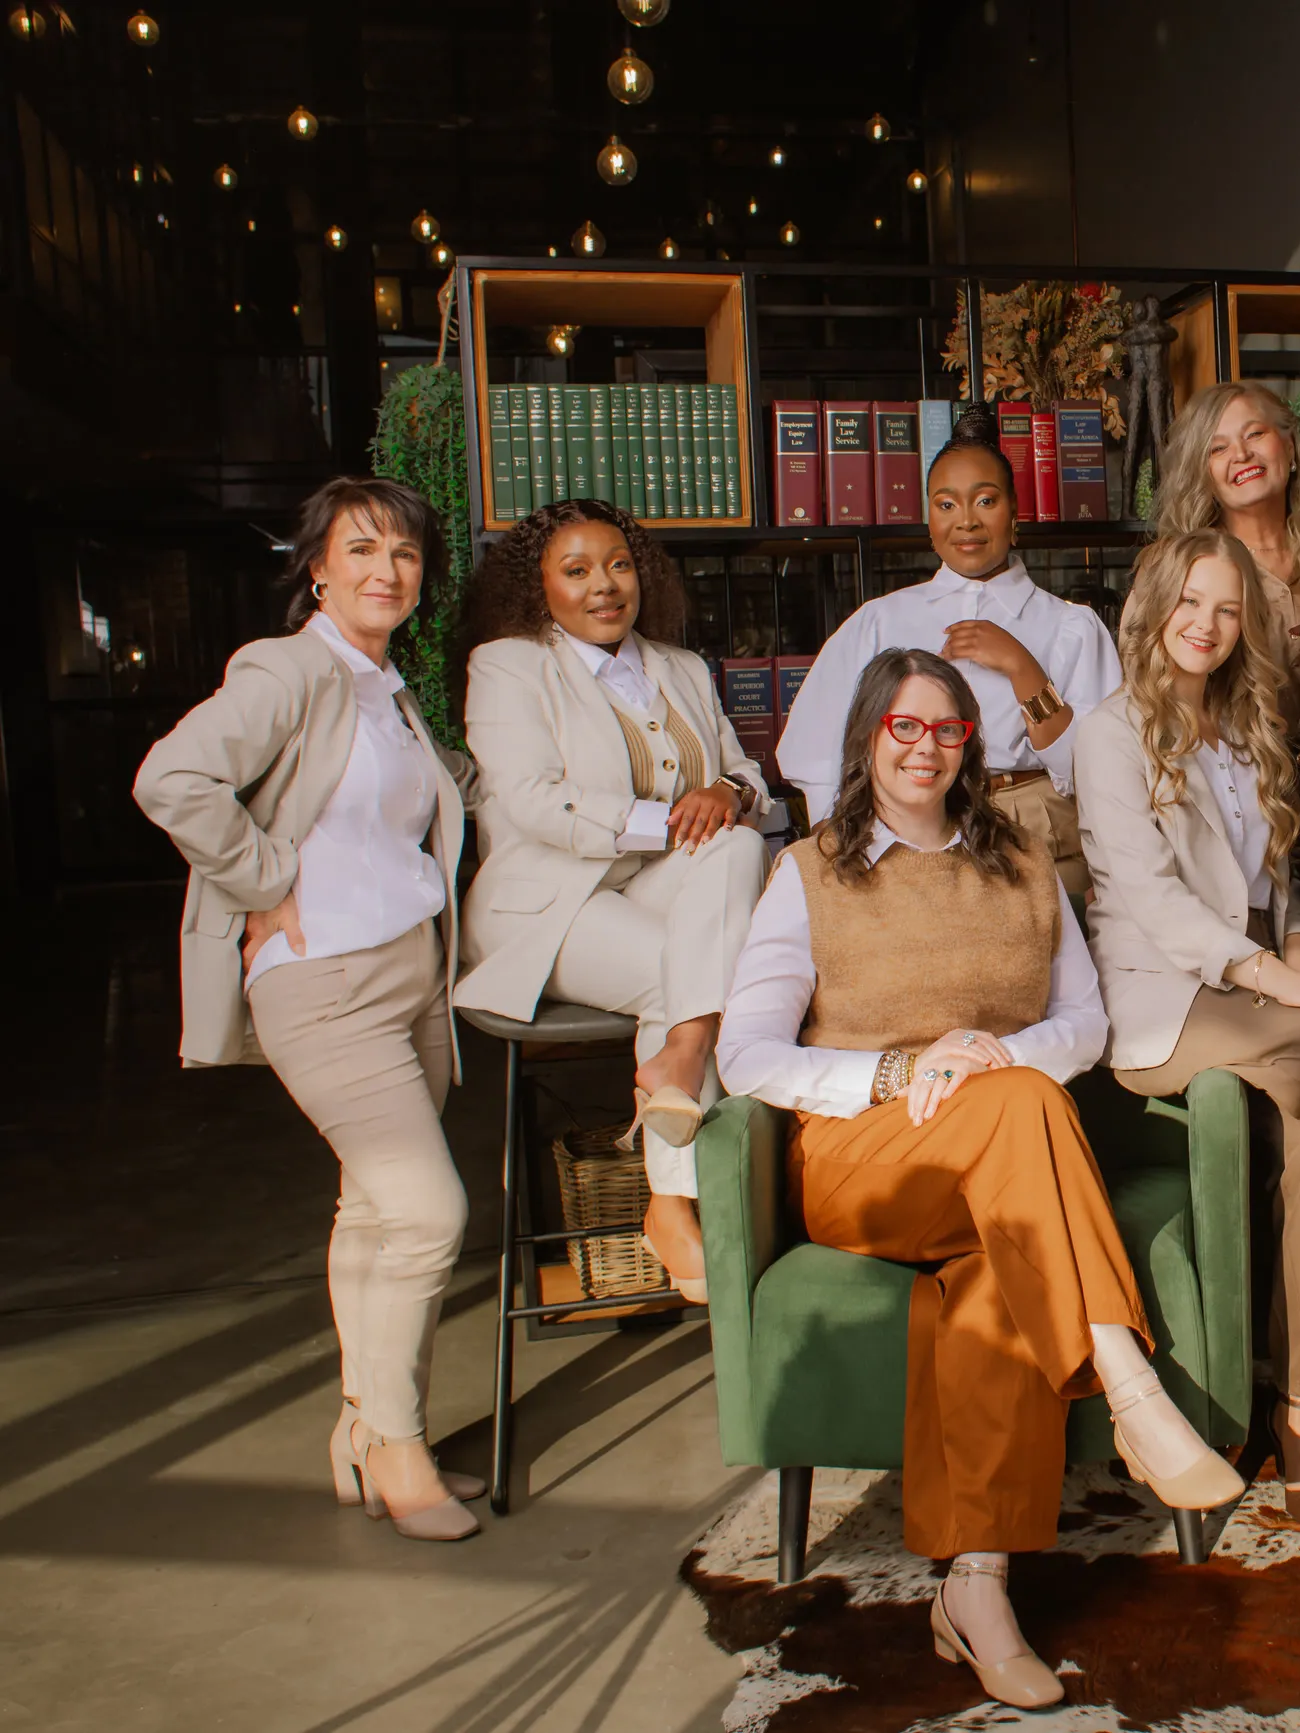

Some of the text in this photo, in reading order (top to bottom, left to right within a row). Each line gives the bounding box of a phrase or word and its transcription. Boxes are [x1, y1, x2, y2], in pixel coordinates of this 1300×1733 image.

[780, 421, 814, 429] Employment
[835, 418, 859, 428] Family
[885, 419, 909, 429] Family
[788, 430, 806, 438] Equity
[840, 428, 855, 436] Law
[890, 429, 904, 437] Law
[835, 437, 860, 445] Service
[885, 438, 910, 446] Service
[733, 682, 765, 690] SUPERIOR
[738, 693, 761, 701] COURT
[734, 704, 767, 713] PRACTICE
